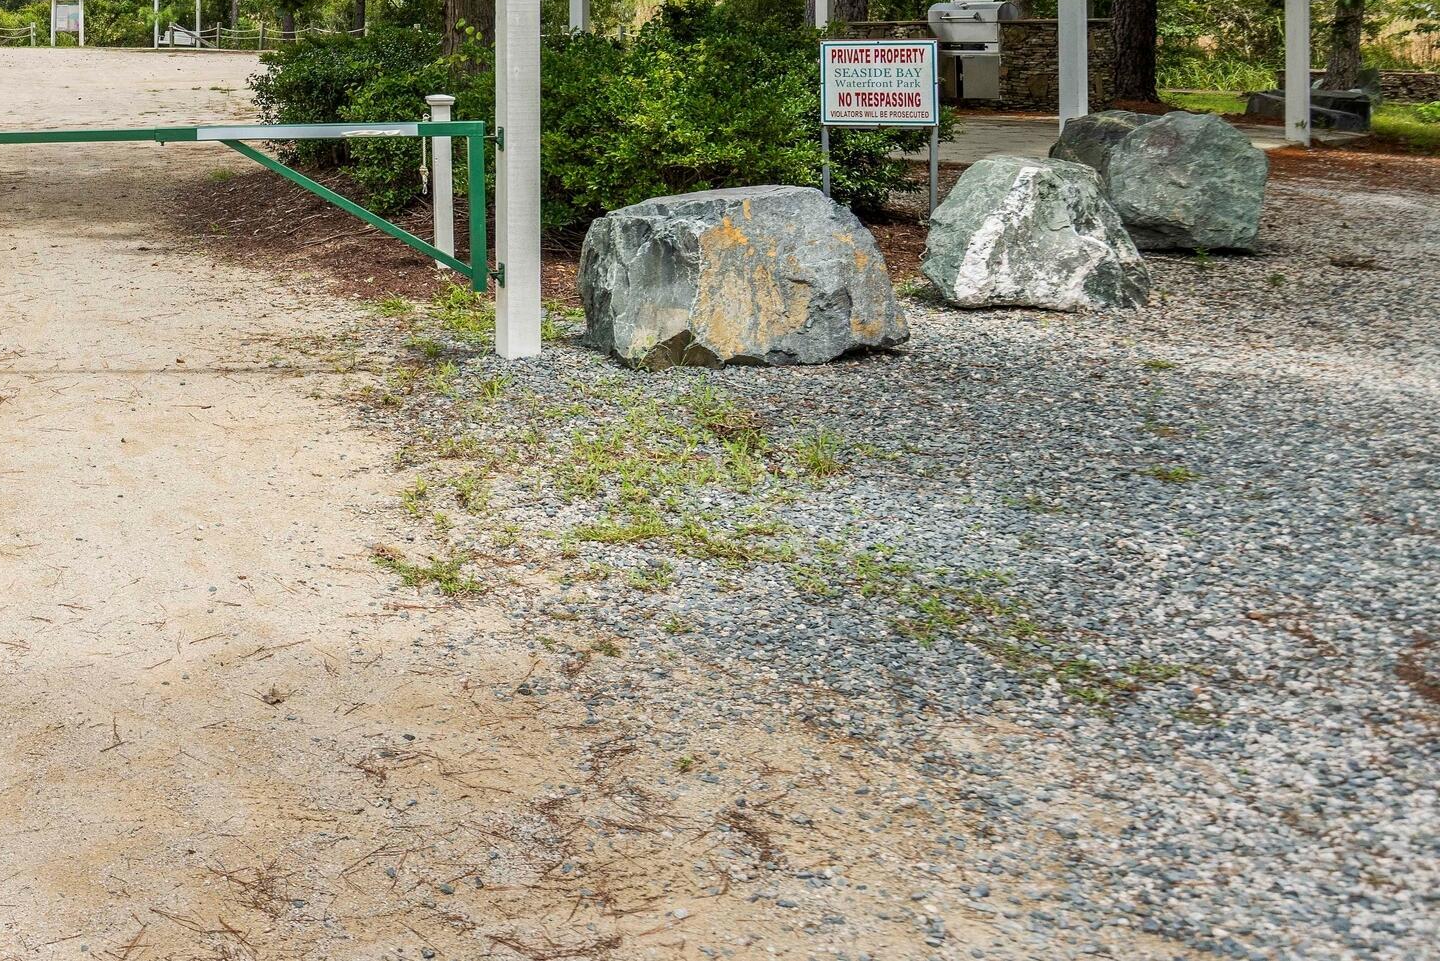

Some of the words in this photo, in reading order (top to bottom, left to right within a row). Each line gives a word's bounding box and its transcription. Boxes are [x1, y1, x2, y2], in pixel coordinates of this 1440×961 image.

[831, 48, 871, 63] PRIVATE
[874, 48, 925, 63] PROPERTY
[834, 68, 892, 78] SEASIDE
[896, 67, 923, 78] BAY
[835, 79, 892, 88] Waterfront
[896, 79, 921, 88] Park
[838, 92, 852, 107] NO
[855, 92, 921, 107] TRESPASSING
[830, 110, 863, 118] VIOLATORS
